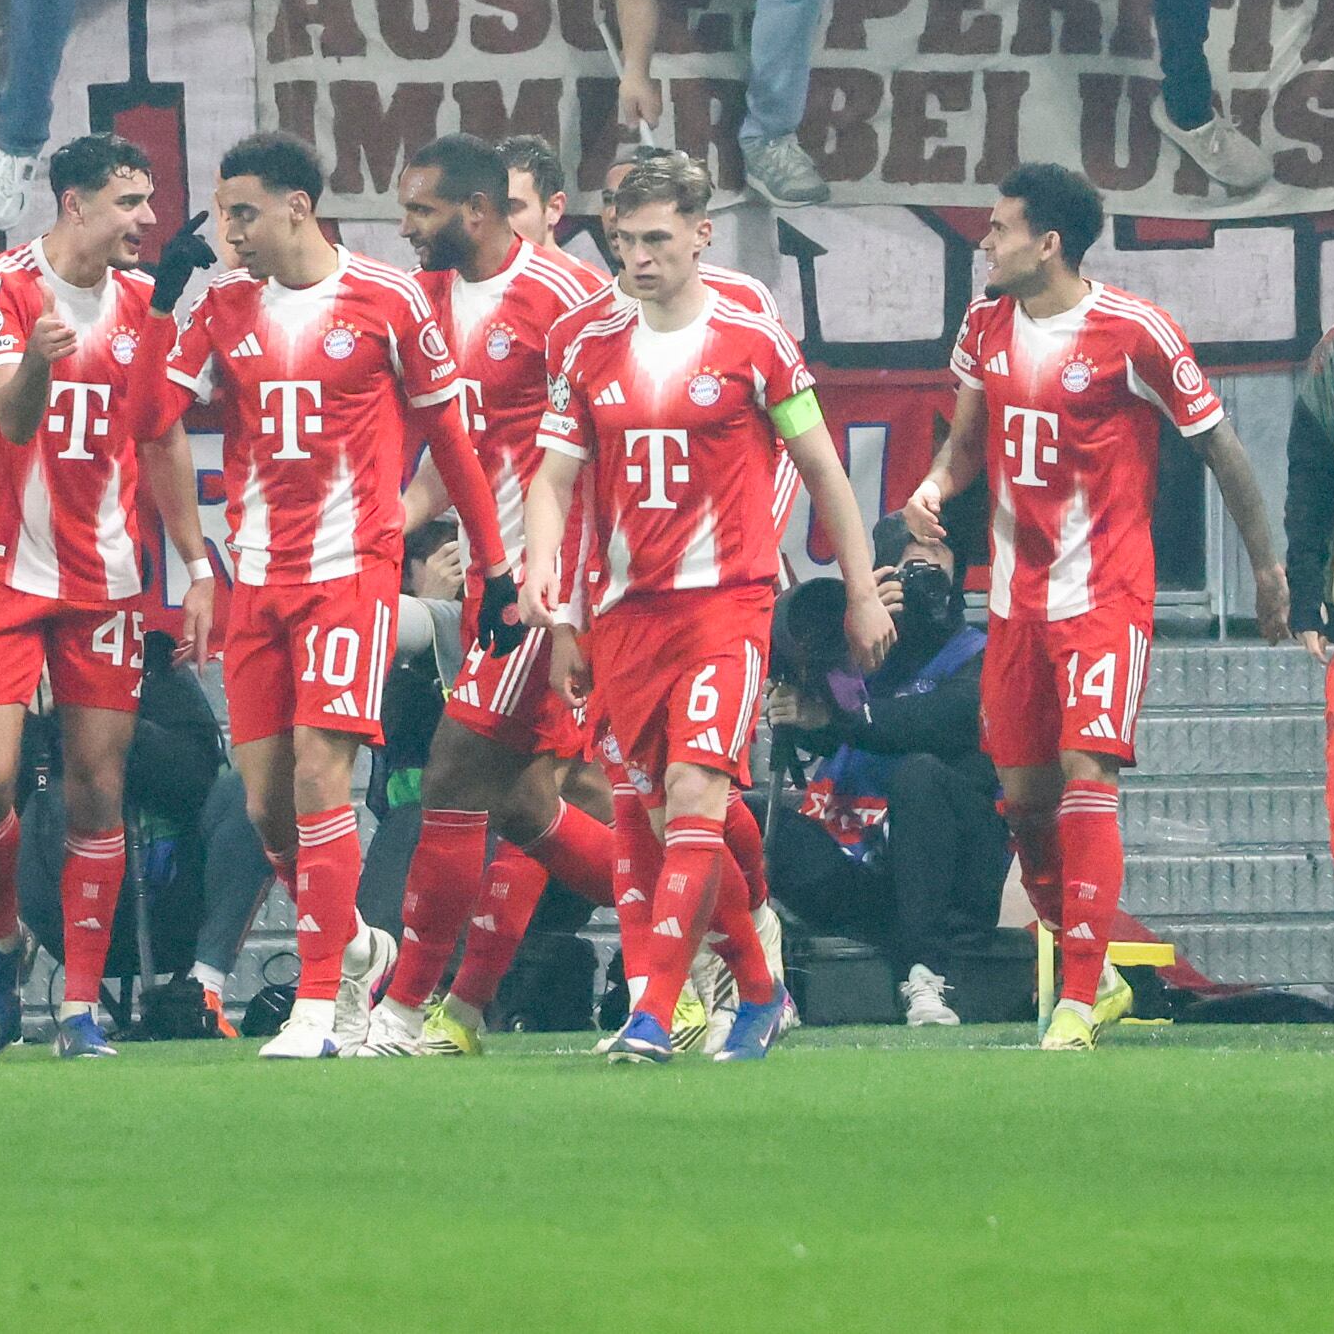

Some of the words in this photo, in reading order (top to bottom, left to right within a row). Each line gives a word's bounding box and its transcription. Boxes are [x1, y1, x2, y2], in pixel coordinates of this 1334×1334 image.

[797, 68, 1031, 184] BEI
[301, 624, 360, 687] 10
[1066, 650, 1116, 710] 14
[685, 665, 720, 722] 6
